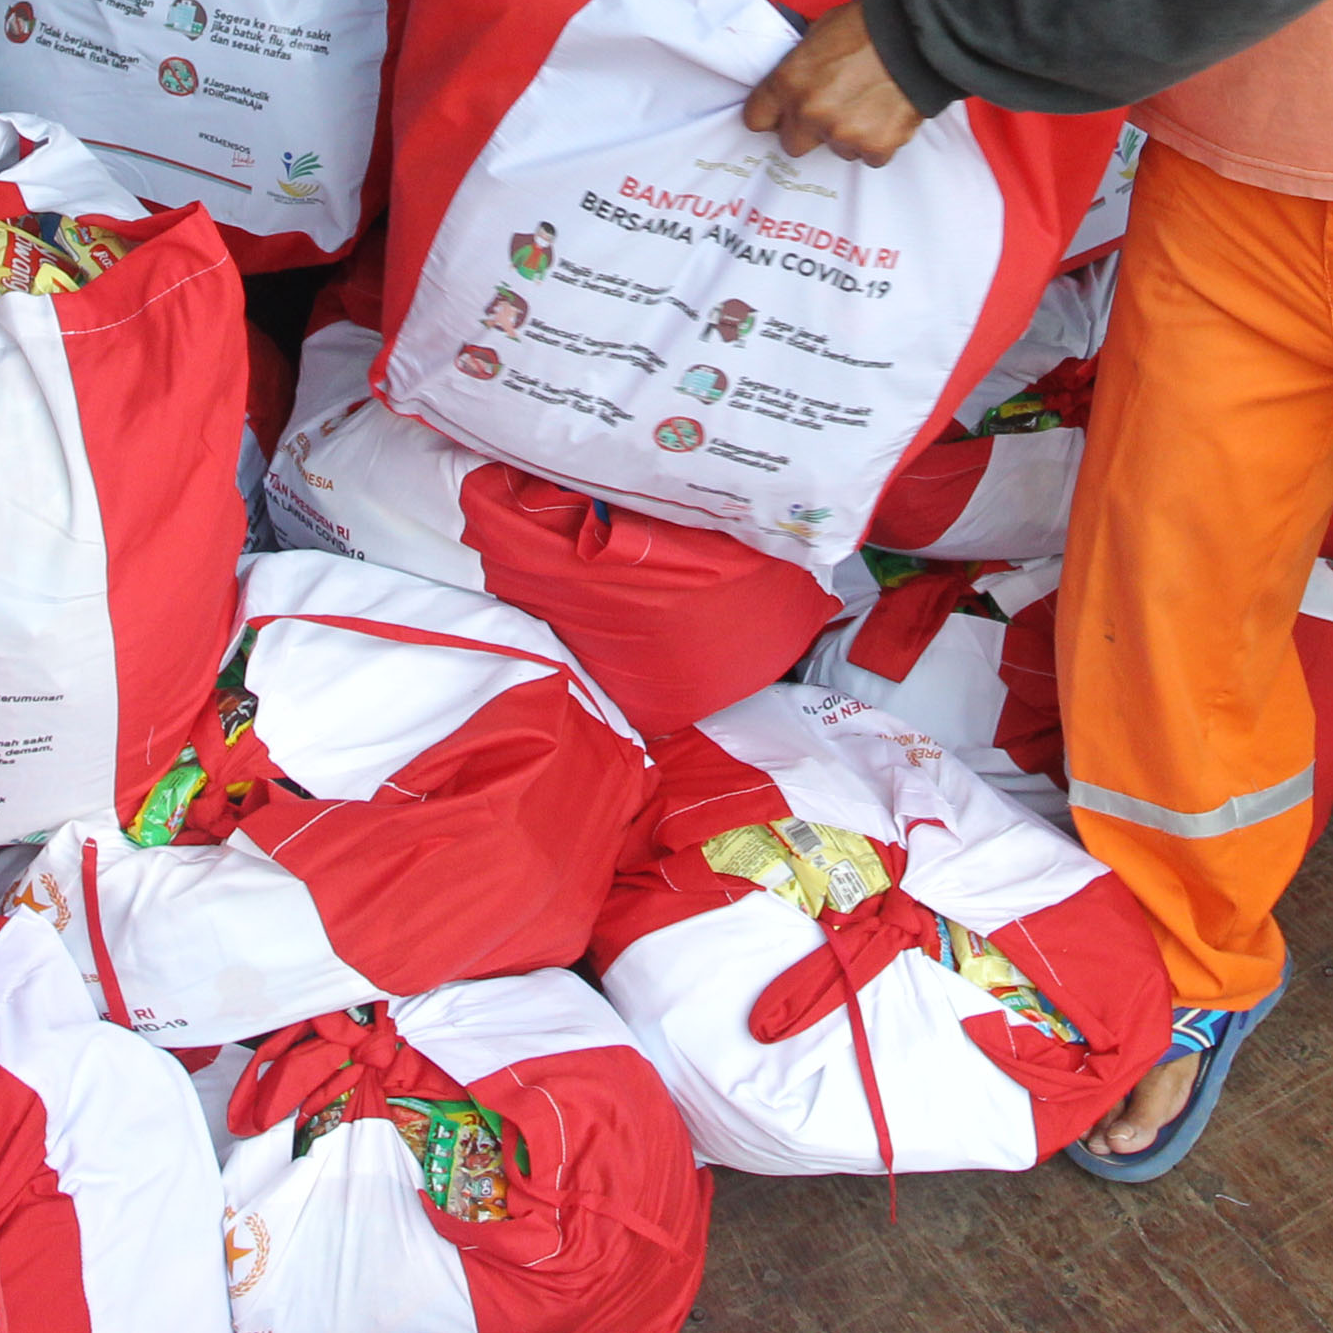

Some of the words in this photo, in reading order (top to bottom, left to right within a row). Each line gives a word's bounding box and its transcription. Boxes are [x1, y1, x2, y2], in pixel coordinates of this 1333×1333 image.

[38, 21, 62, 39] Tidak
[63, 31, 104, 53] berjabat
[210, 20, 231, 34] jika
[232, 25, 266, 44] batuk,
[289, 38, 331, 57] demam,
[213, 9, 252, 27] Segera
[253, 18, 267, 30] ke
[268, 23, 304, 38] rumah
[306, 28, 333, 43] sakit
[35, 35, 52, 49] dan
[53, 40, 87, 61] kontak
[89, 50, 110, 66] fisik
[210, 34, 230, 47] dan
[231, 39, 261, 55] sesak
[262, 47, 292, 61] nafas
[202, 87, 264, 112] #DiRumahAja
[203, 77, 270, 103] #JanganMudik
[579, 190, 695, 245] BERSAMA
[701, 223, 778, 267] AWAN
[780, 252, 893, 300] COVID-19
[745, 207, 872, 268] PRESIDEN
[873, 248, 902, 271] RI
[336, 525, 351, 542] RI
[4, 745, 54, 757] demam,
[22, 735, 54, 746] sakit
[133, 1007, 156, 1021] RI
